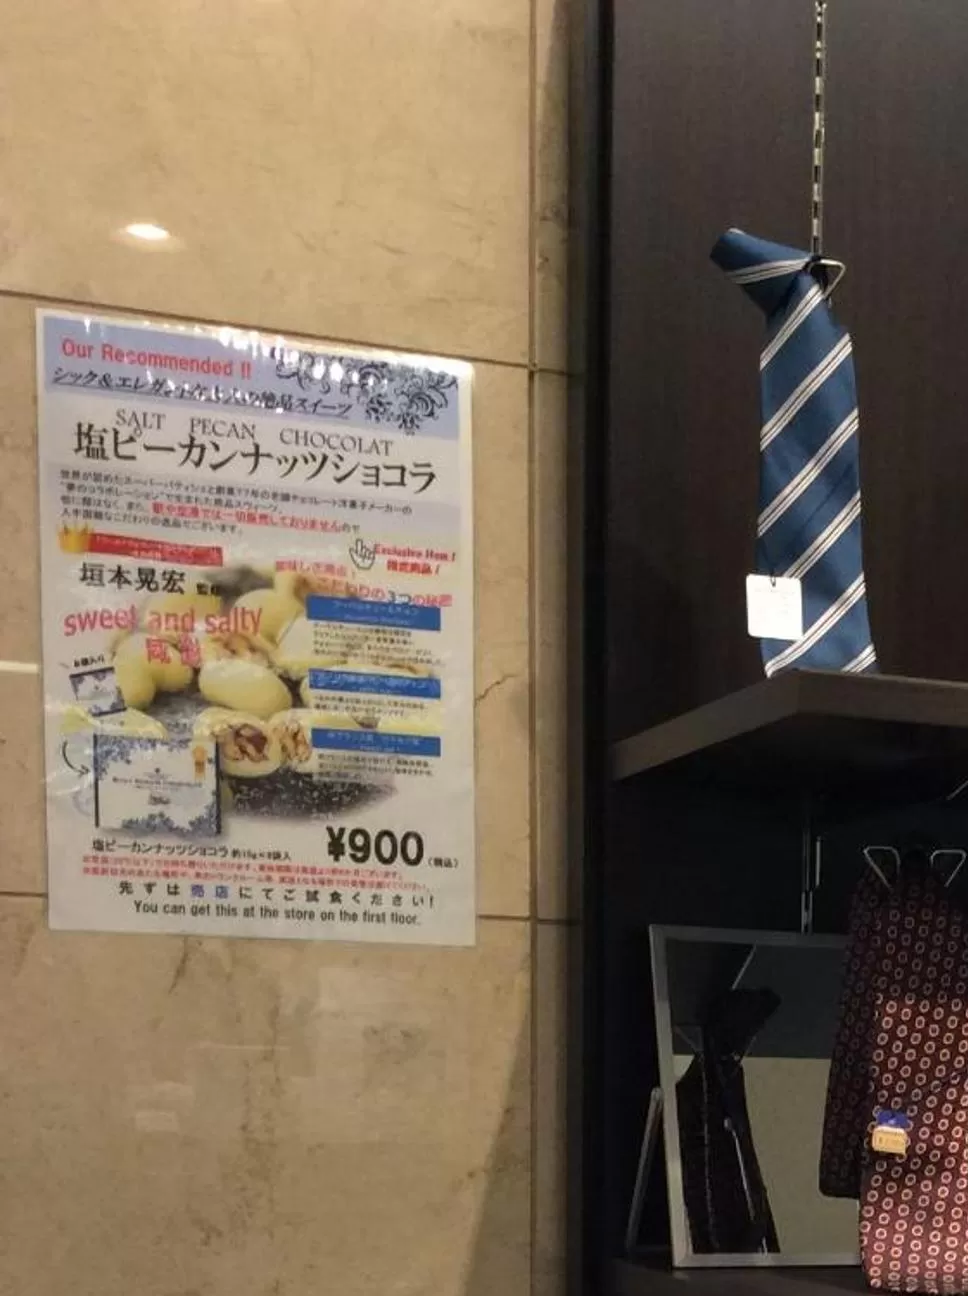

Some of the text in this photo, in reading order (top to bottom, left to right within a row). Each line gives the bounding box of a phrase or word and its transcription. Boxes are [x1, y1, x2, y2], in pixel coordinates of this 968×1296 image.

[62, 338, 94, 359] Our
[101, 343, 233, 377] Recommended
[116, 407, 393, 456] SALT PECAN CHOCOLAT
[73, 421, 437, 494] 塩ピーカンナッツショコラ
[79, 560, 186, 595] 垣本晃宏
[63, 604, 263, 637] sweet and salty
[326, 825, 425, 867] ¥900
[134, 900, 158, 914] You
[163, 905, 186, 915] can
[191, 902, 211, 917] get
[215, 904, 238, 917] this
[243, 906, 256, 917] at
[260, 906, 279, 918] the
[284, 909, 316, 921] store
[320, 911, 335, 921] on
[339, 908, 359, 921] the
[362, 911, 386, 923] first
